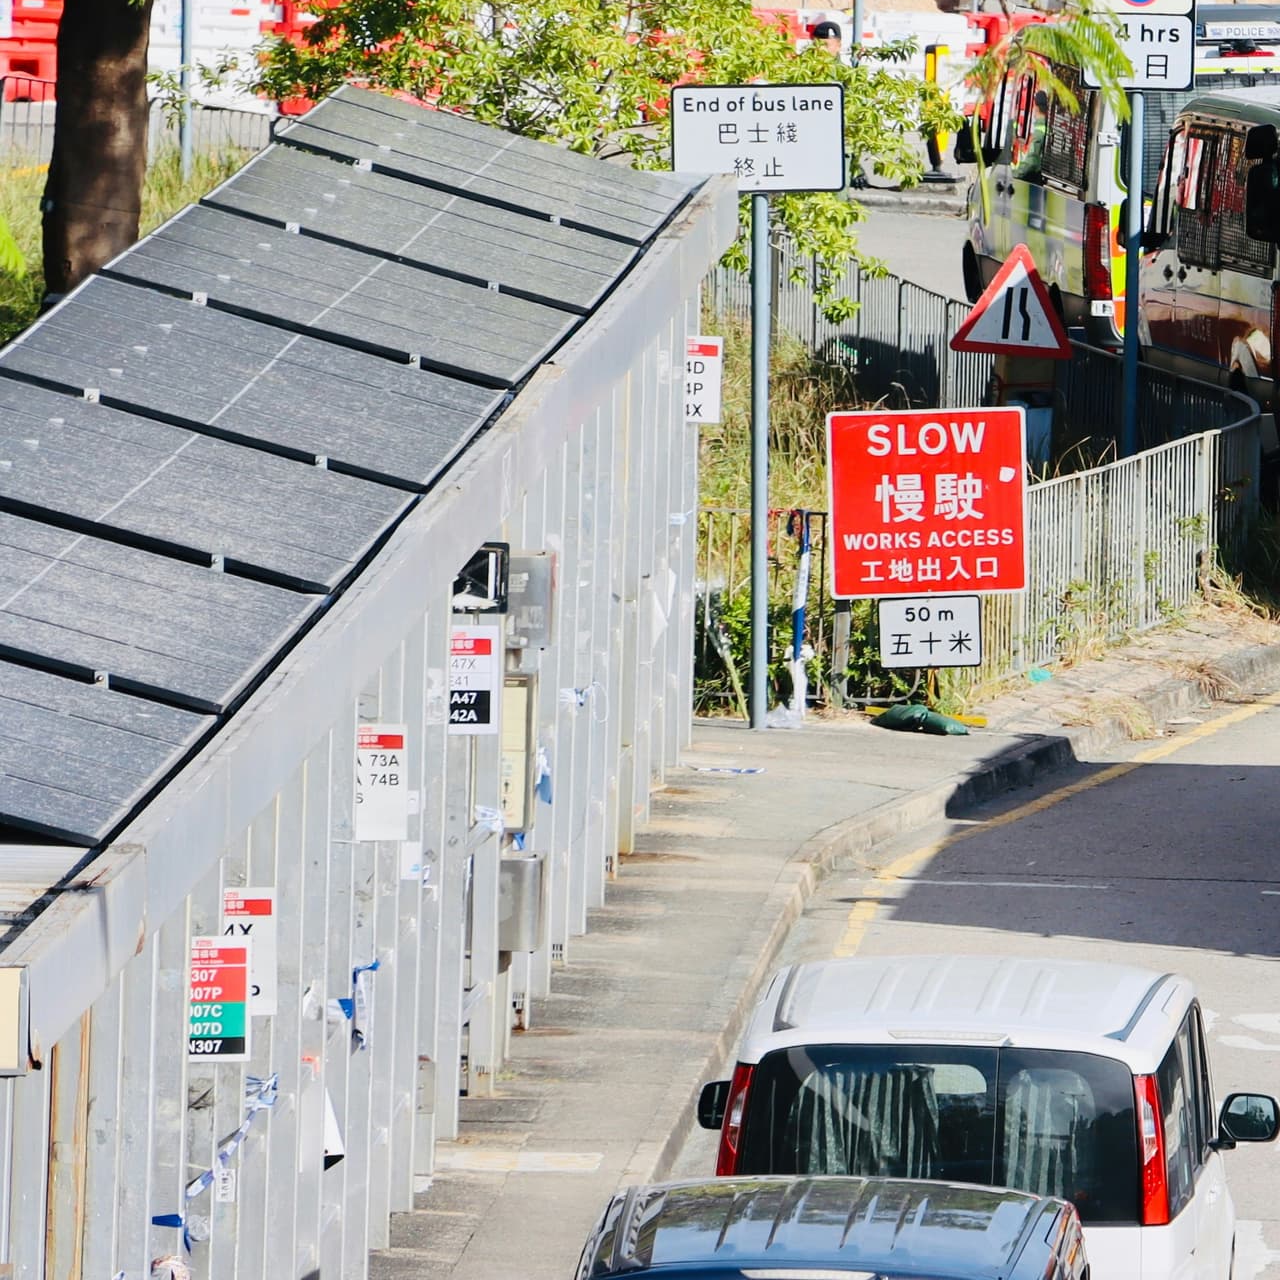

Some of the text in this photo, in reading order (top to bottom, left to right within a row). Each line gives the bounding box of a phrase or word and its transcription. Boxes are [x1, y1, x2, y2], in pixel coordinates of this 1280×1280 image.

[1141, 24, 1180, 42] hrs
[1226, 27, 1265, 36] POLICE
[683, 95, 834, 113] End of bus lane
[734, 157, 785, 179] 終止
[867, 422, 986, 456] SLOW
[874, 472, 985, 524] 慢駛
[843, 528, 1014, 551] WORKS ACCESS
[860, 556, 999, 583] 工地出入口
[905, 607, 954, 622] 50 m
[890, 630, 973, 656] 五十米
[370, 754, 400, 767] 73A
[370, 773, 400, 786] 74B
